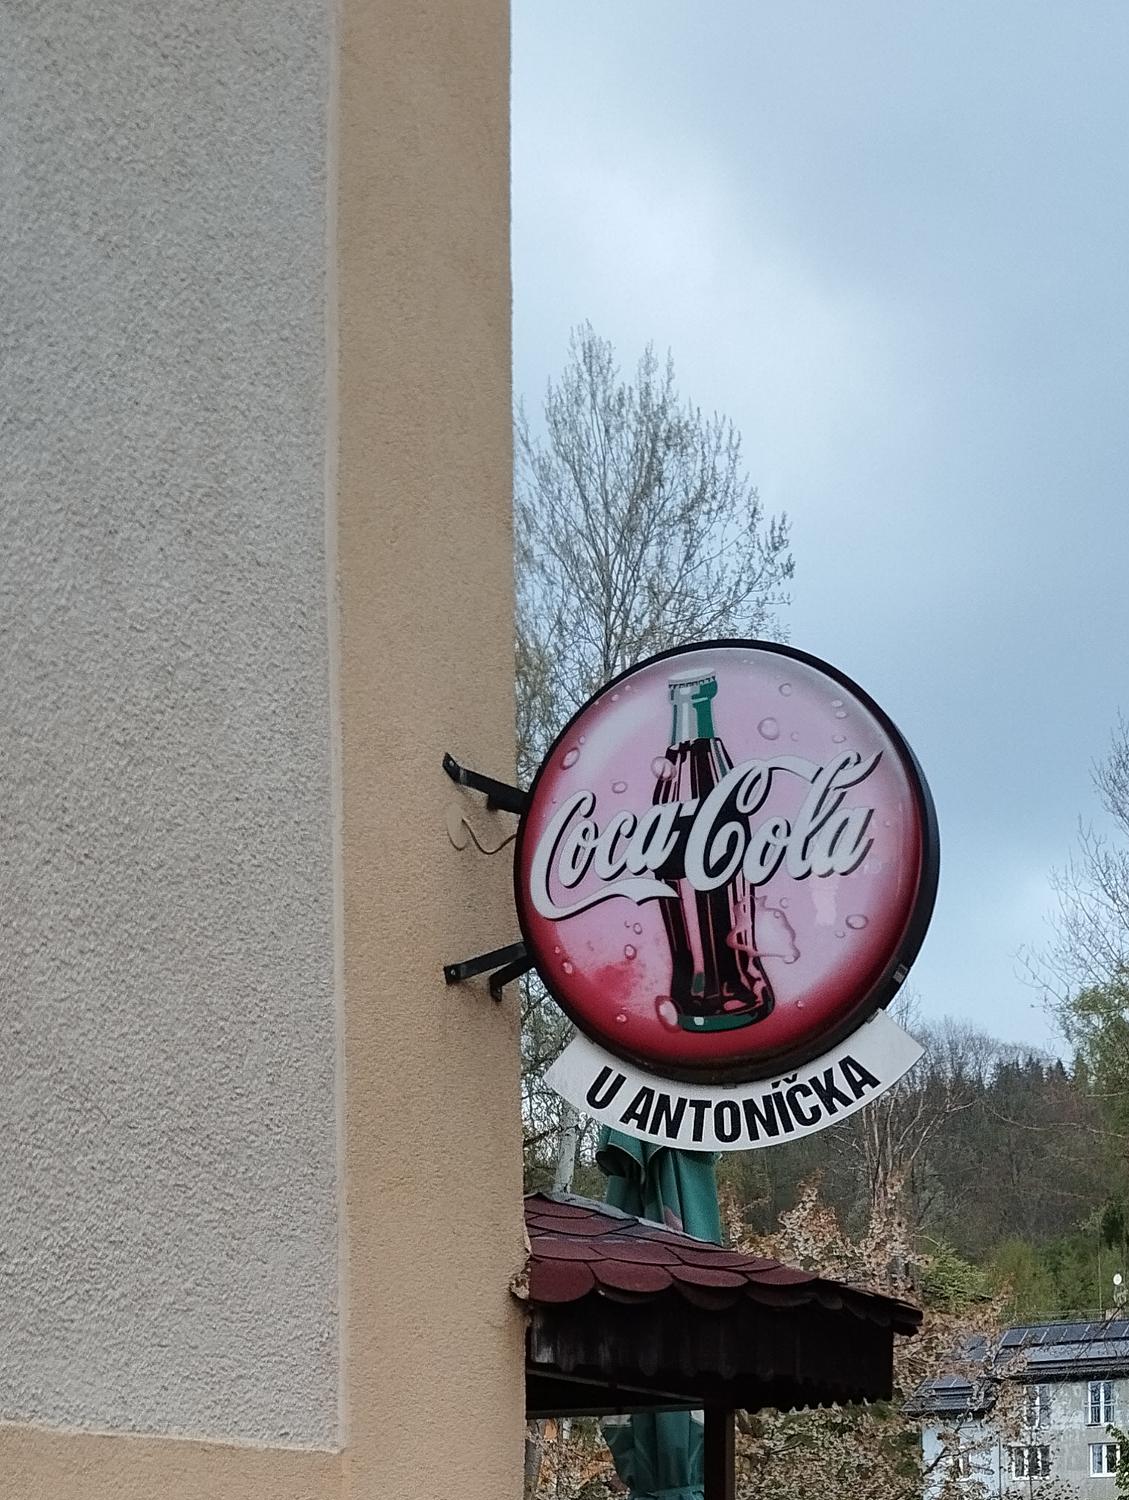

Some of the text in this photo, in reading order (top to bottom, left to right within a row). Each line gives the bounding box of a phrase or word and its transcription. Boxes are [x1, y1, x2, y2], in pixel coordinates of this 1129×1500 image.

[530, 750, 884, 921] Coca-Cola
[586, 1055, 882, 1143] U ANTONÍČKA
